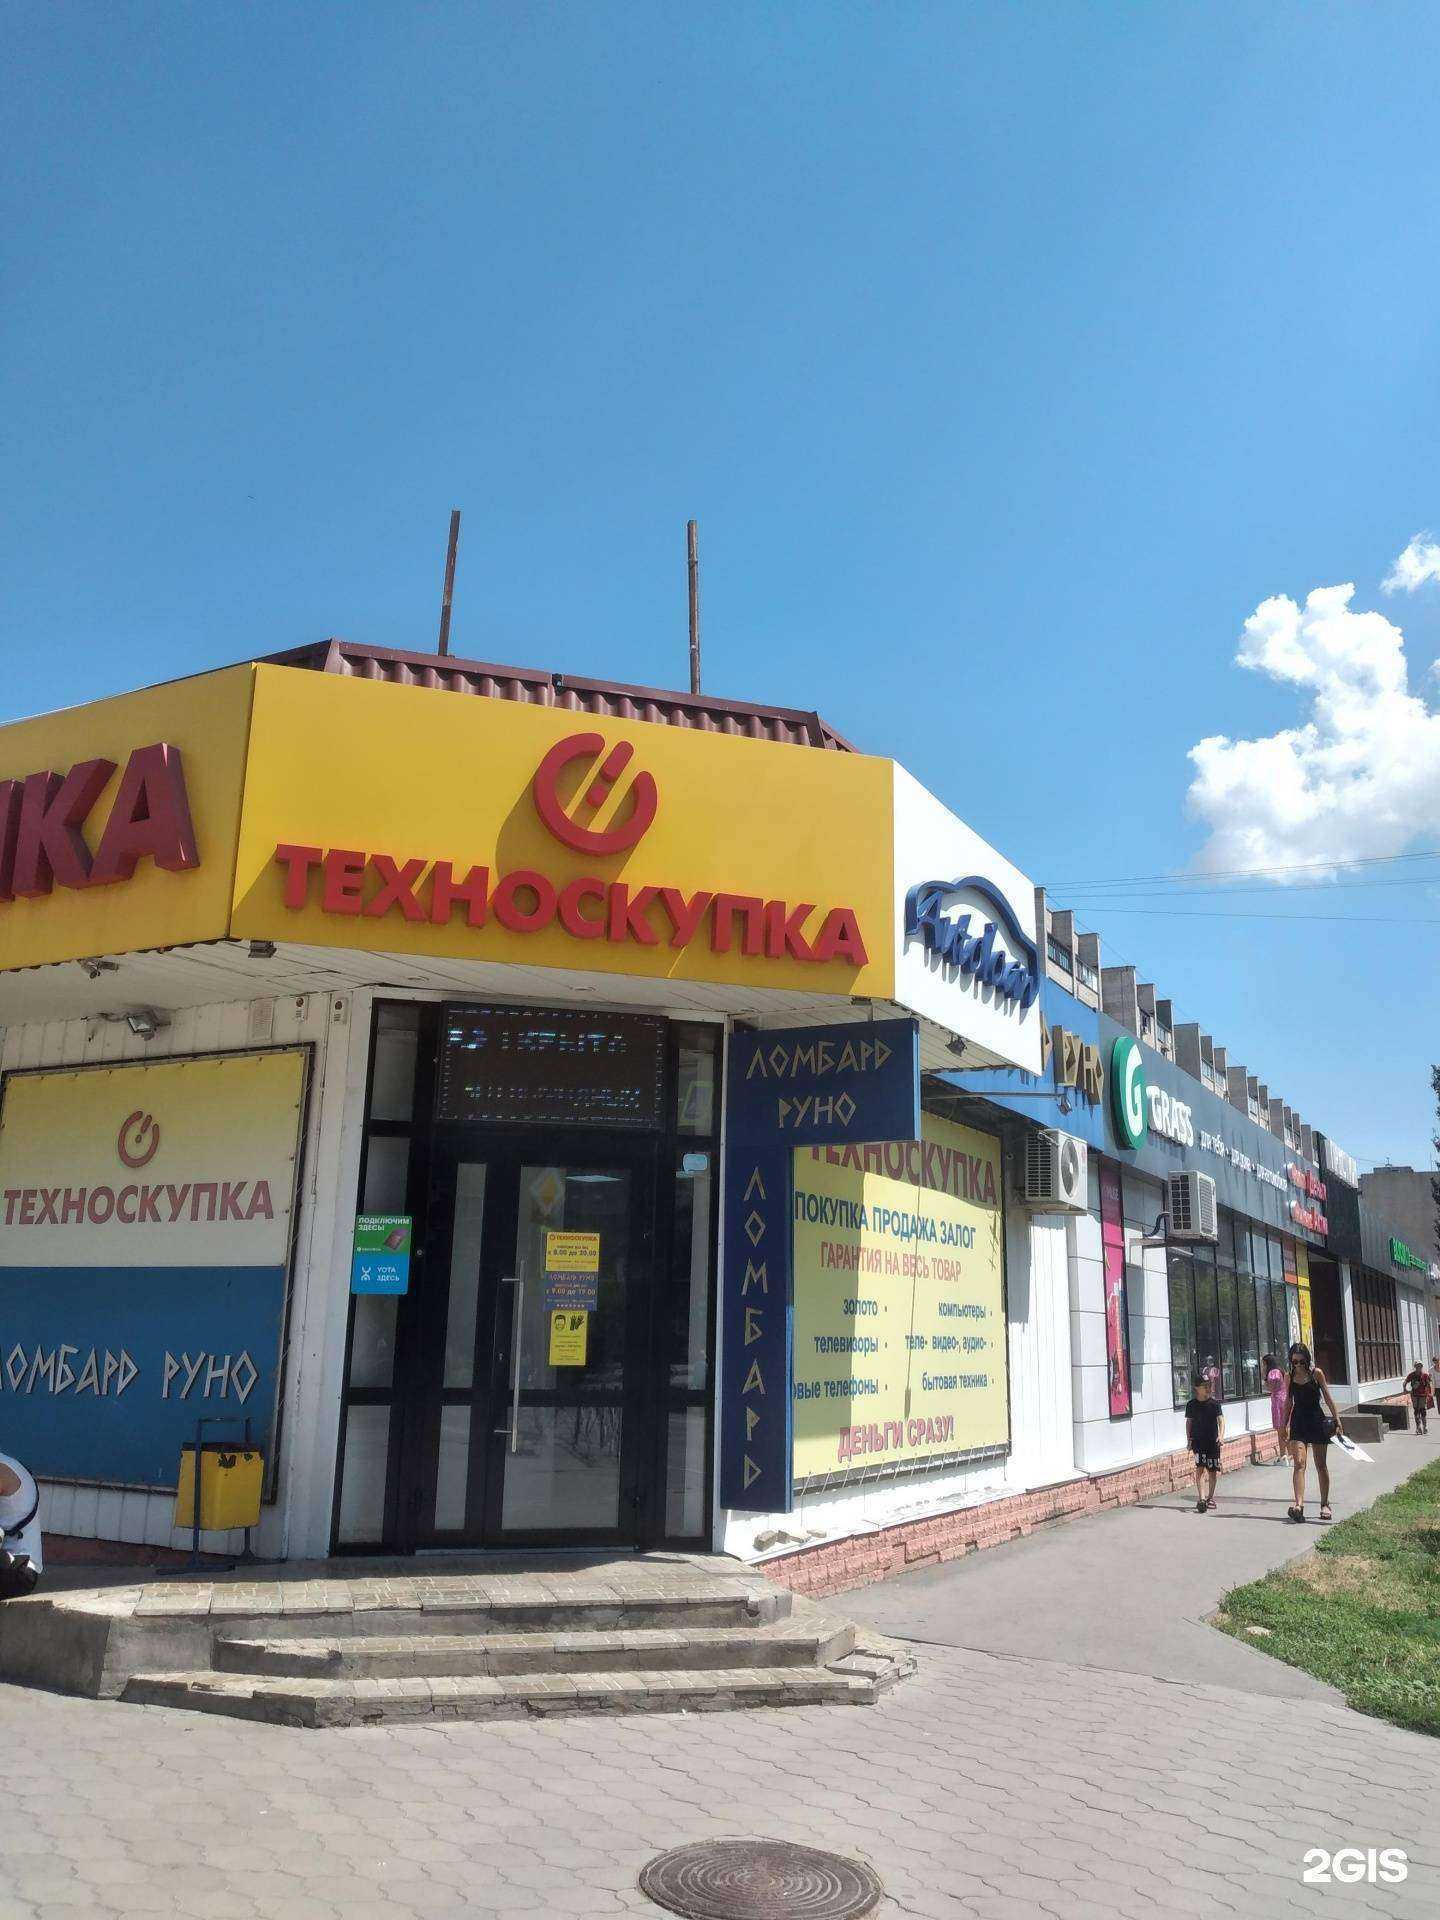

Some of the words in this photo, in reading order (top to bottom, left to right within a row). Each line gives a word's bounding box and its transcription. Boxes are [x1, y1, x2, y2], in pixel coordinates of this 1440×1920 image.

[275, 843, 870, 966] ТЕХНОСКУПКА
[746, 1038, 893, 1081] ЛОМБАРД
[777, 1091, 857, 1129] РУНО
[1145, 1085, 1194, 1148] GRASS
[3, 1180, 274, 1226] ТЕХНОСКУПКА
[358, 1217, 410, 1225] ПОДКЛЮЧИМ
[794, 1191, 869, 1231] ПОКУПКА
[872, 1206, 938, 1243] ПРОДАЖА
[940, 1220, 977, 1250] ЗАЛОГ
[820, 1241, 883, 1276] ГАРАНТИЯ
[885, 1251, 900, 1276] НА
[902, 1253, 930, 1280] ВЕСЬ
[932, 1257, 962, 1283] ТОВАР
[843, 1299, 878, 1316] золото
[938, 1302, 987, 1322] компьютеры
[814, 1334, 879, 1357] телевизоры
[0, 1343, 139, 1396] ОМБАРД
[162, 1350, 259, 1404] РУНО
[824, 1376, 879, 1401] телефоны
[922, 1372, 957, 1392] бытовая
[959, 1373, 988, 1388] техника
[837, 1420, 903, 1463] ДЕНЬГИ
[907, 1414, 955, 1447] СРАЗУ!
